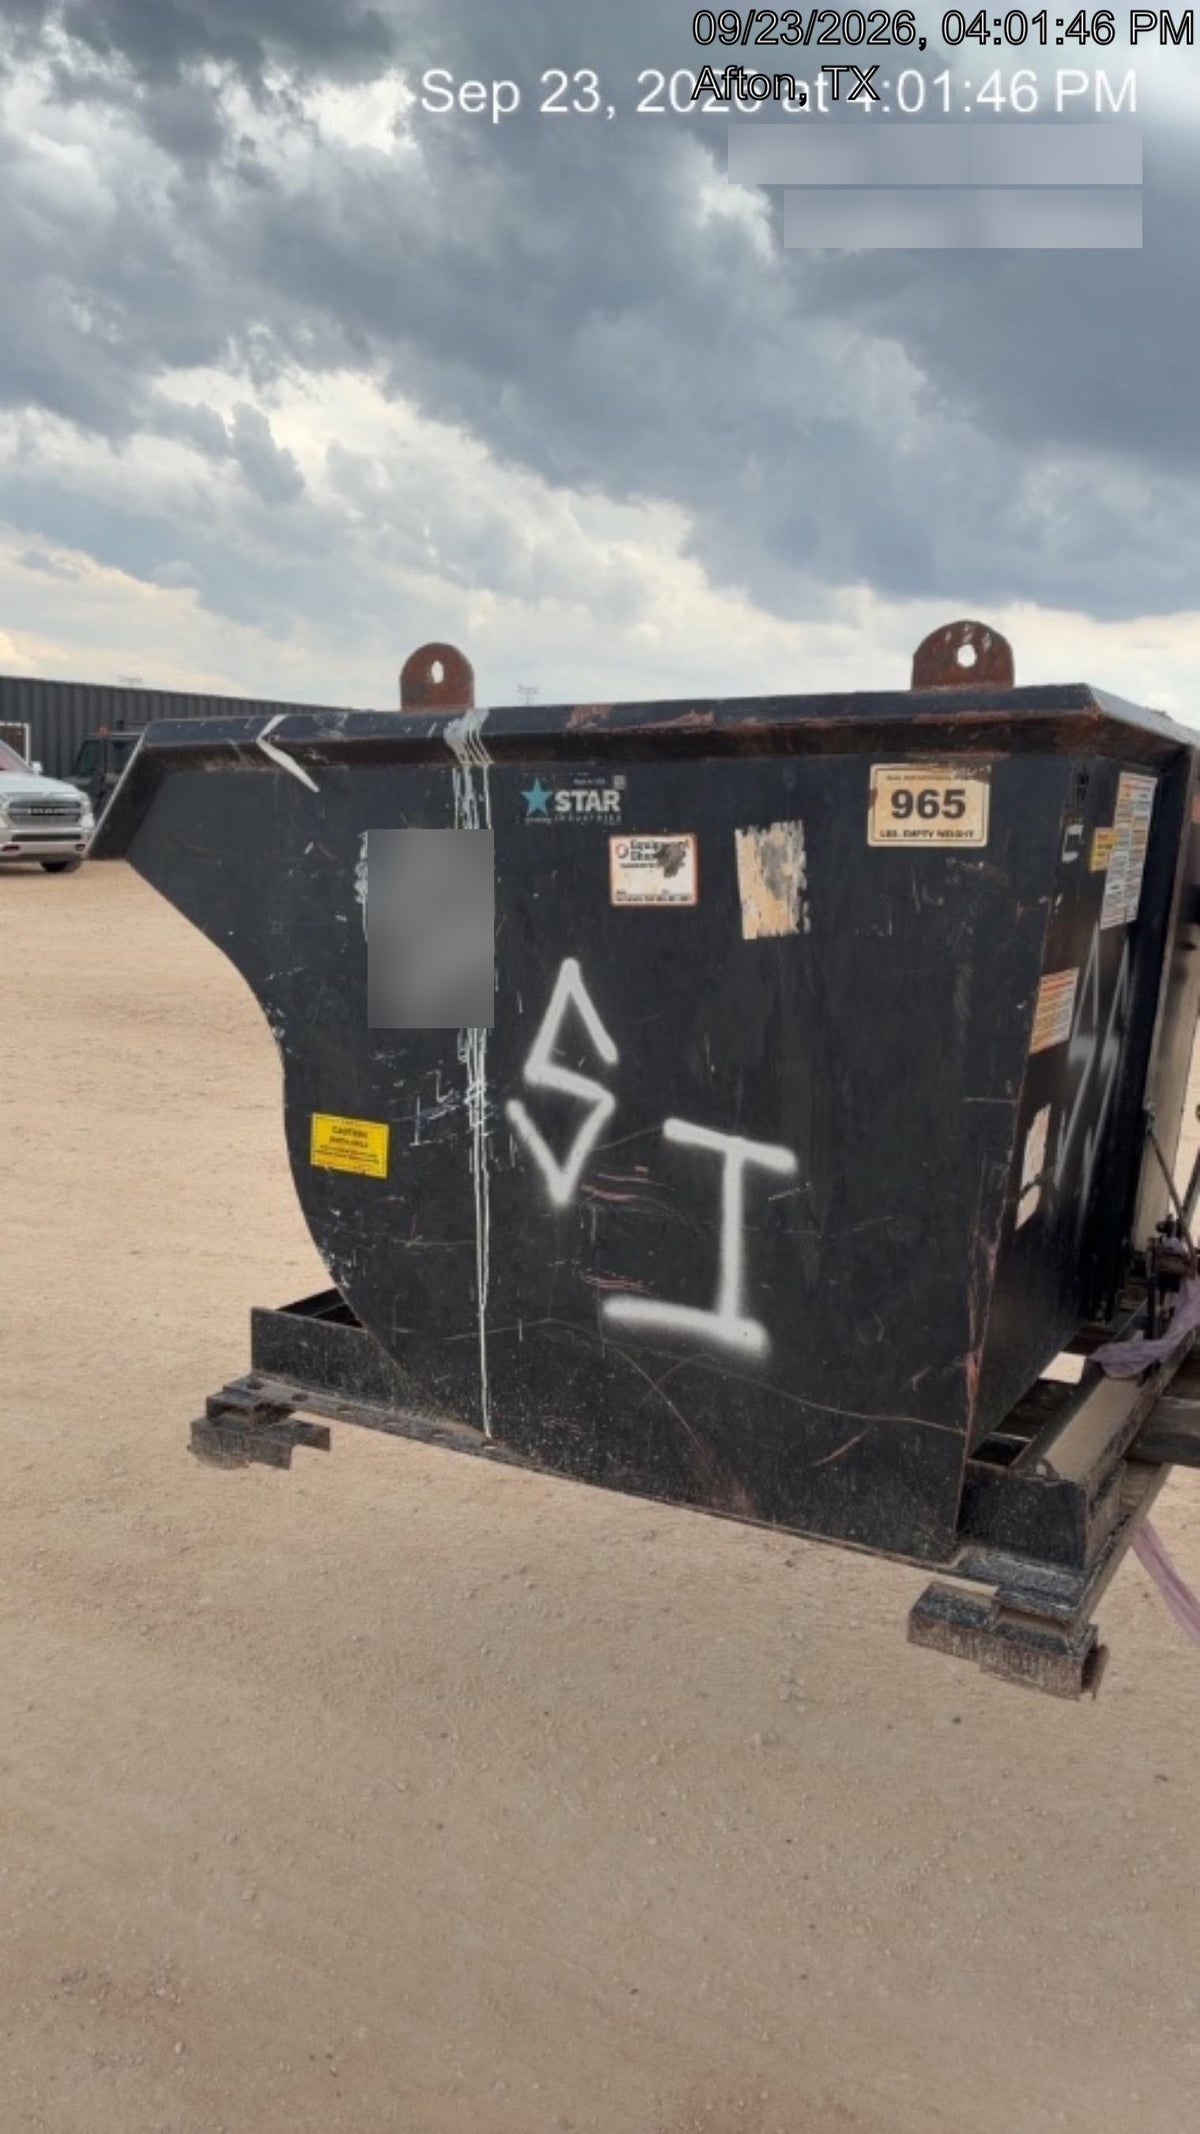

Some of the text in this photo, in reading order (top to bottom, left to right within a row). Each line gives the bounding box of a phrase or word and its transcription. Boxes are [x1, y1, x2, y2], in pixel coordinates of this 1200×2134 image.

[554, 789, 621, 812] STAR
[891, 788, 966, 819] 965
[903, 829, 934, 838] EMPTY
[332, 1126, 367, 1138] CAUTION
[506, 957, 798, 1357] S I
